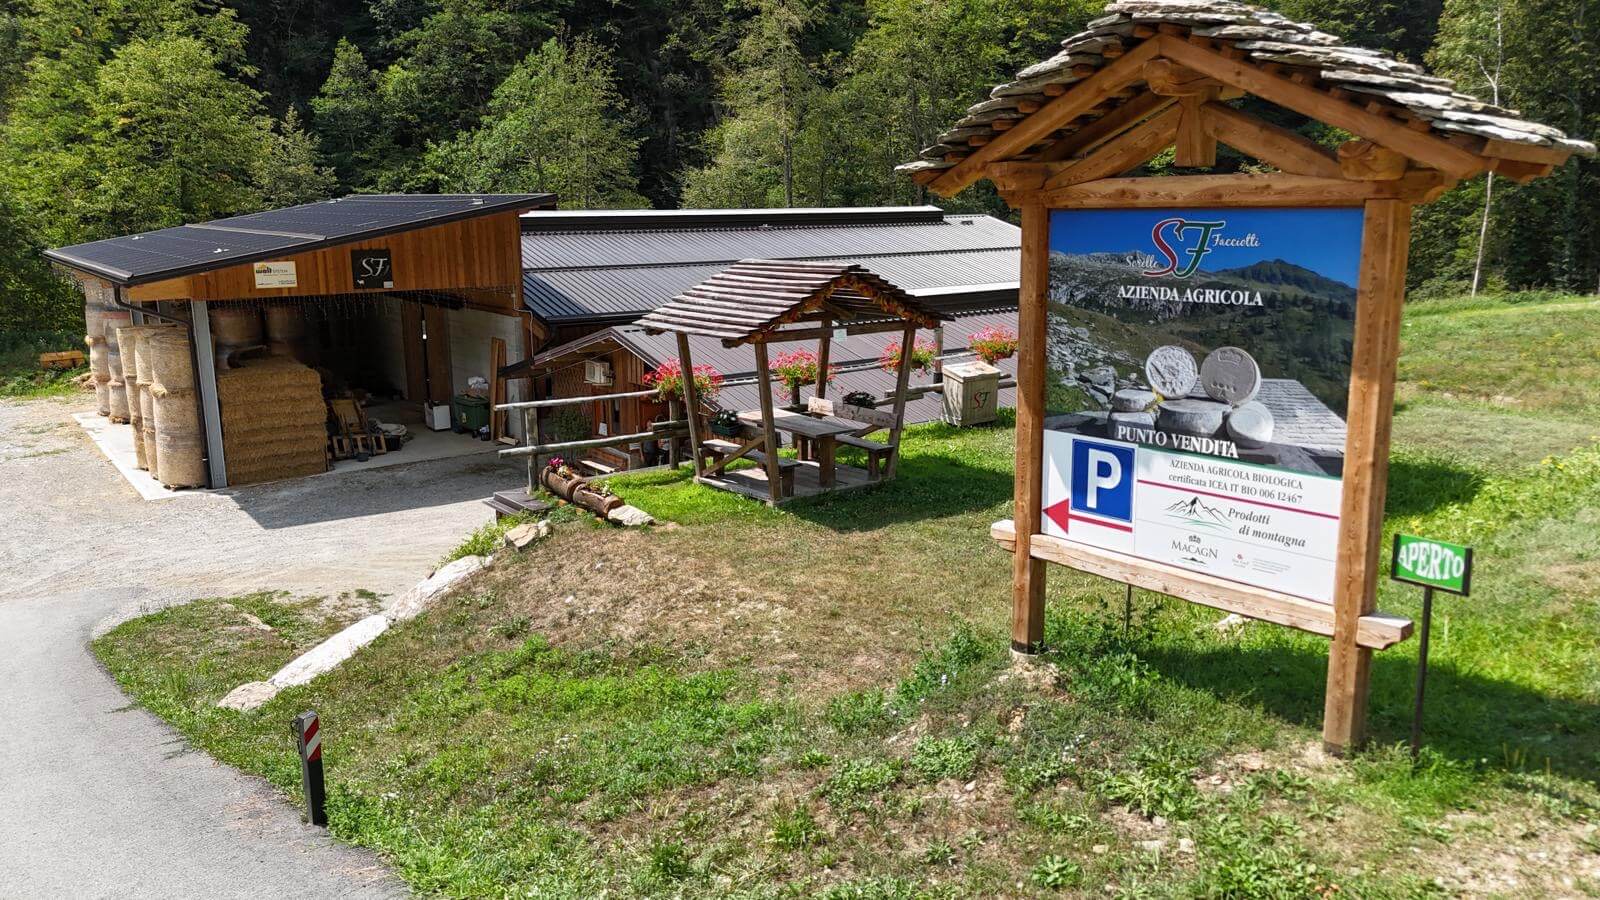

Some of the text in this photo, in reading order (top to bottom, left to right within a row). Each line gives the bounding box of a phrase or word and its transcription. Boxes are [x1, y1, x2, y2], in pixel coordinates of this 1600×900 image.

[1211, 233, 1261, 247] Facciotti
[1117, 285, 1264, 306] AZIENDA AGRICOLA
[1118, 425, 1239, 459] PUNTO VENDITA
[1086, 448, 1122, 509] P
[1170, 459, 1303, 490] AZIENDA AGRICOLA BIOLOGICA
[1168, 474, 1207, 487] certificata
[1208, 480, 1228, 491] ICEA
[1230, 483, 1239, 493] IT
[1241, 485, 1257, 496] BIO
[1259, 488, 1275, 500] 006
[1228, 507, 1271, 525] Prodotti
[1238, 525, 1306, 547] di montagna
[1171, 540, 1218, 559] MACAGN
[1398, 541, 1465, 580] APERTO
